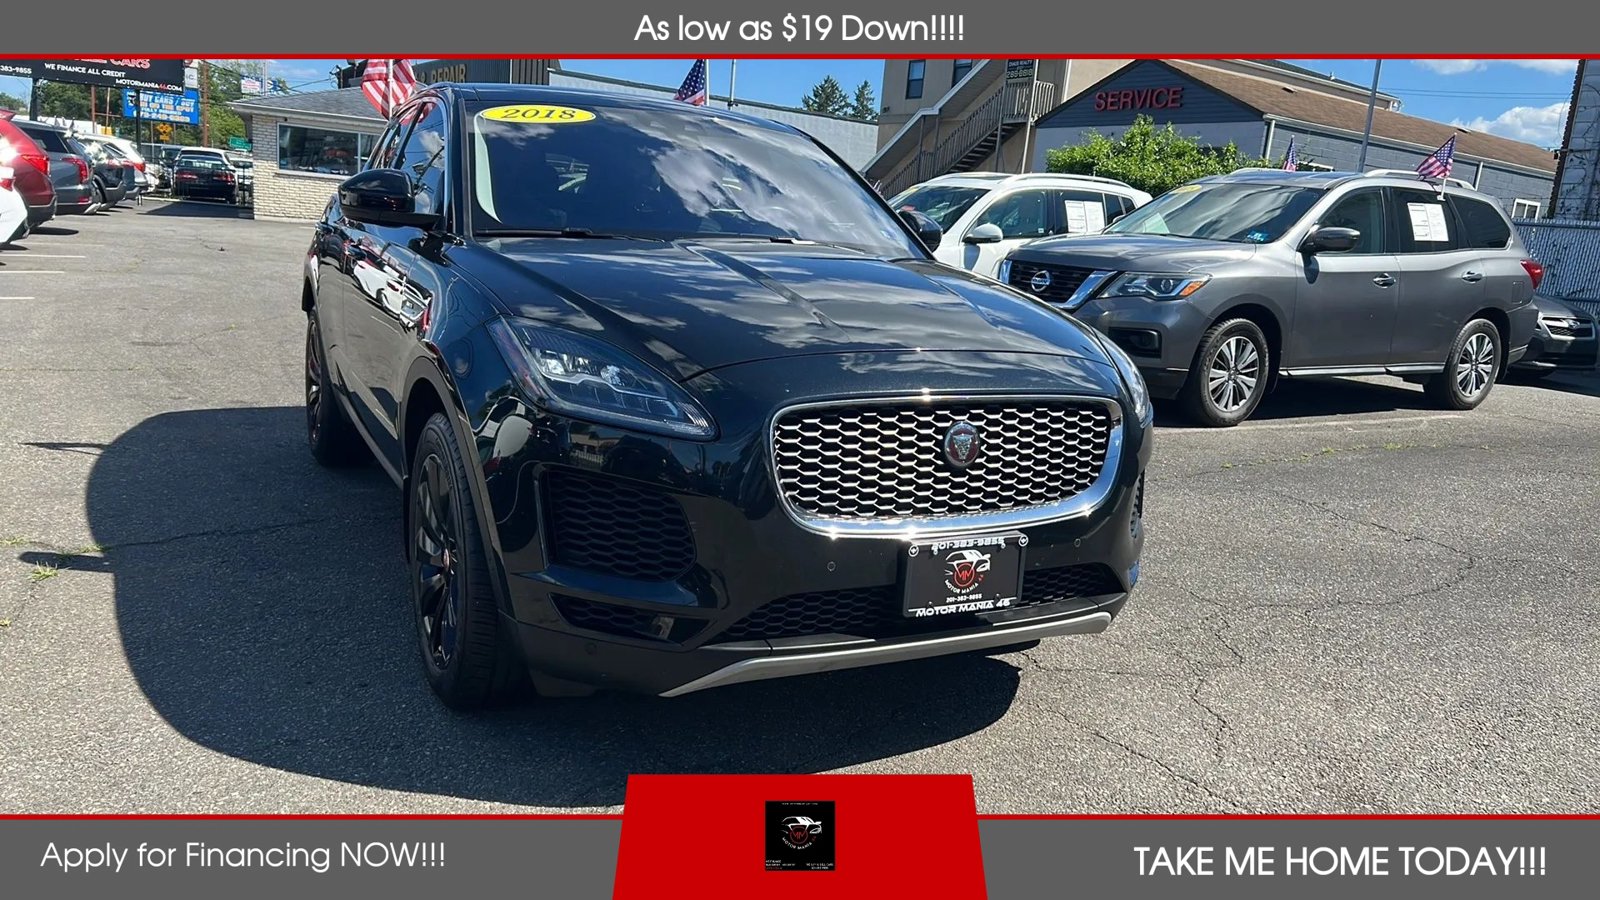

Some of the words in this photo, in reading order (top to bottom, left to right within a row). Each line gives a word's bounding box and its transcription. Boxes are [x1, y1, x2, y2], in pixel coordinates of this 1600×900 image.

[56, 64, 87, 74] FINANCE
[101, 69, 126, 78] CREDIT
[431, 63, 466, 84] REPAIR
[154, 95, 174, 105] CARS
[1094, 86, 1184, 112] SERVICE
[501, 108, 576, 120] 2018
[944, 579, 961, 594] MOTOR
[961, 582, 979, 594] MANIA
[915, 605, 957, 618] MOTOR
[958, 600, 995, 613] MANIA
[996, 598, 1011, 608] 46
